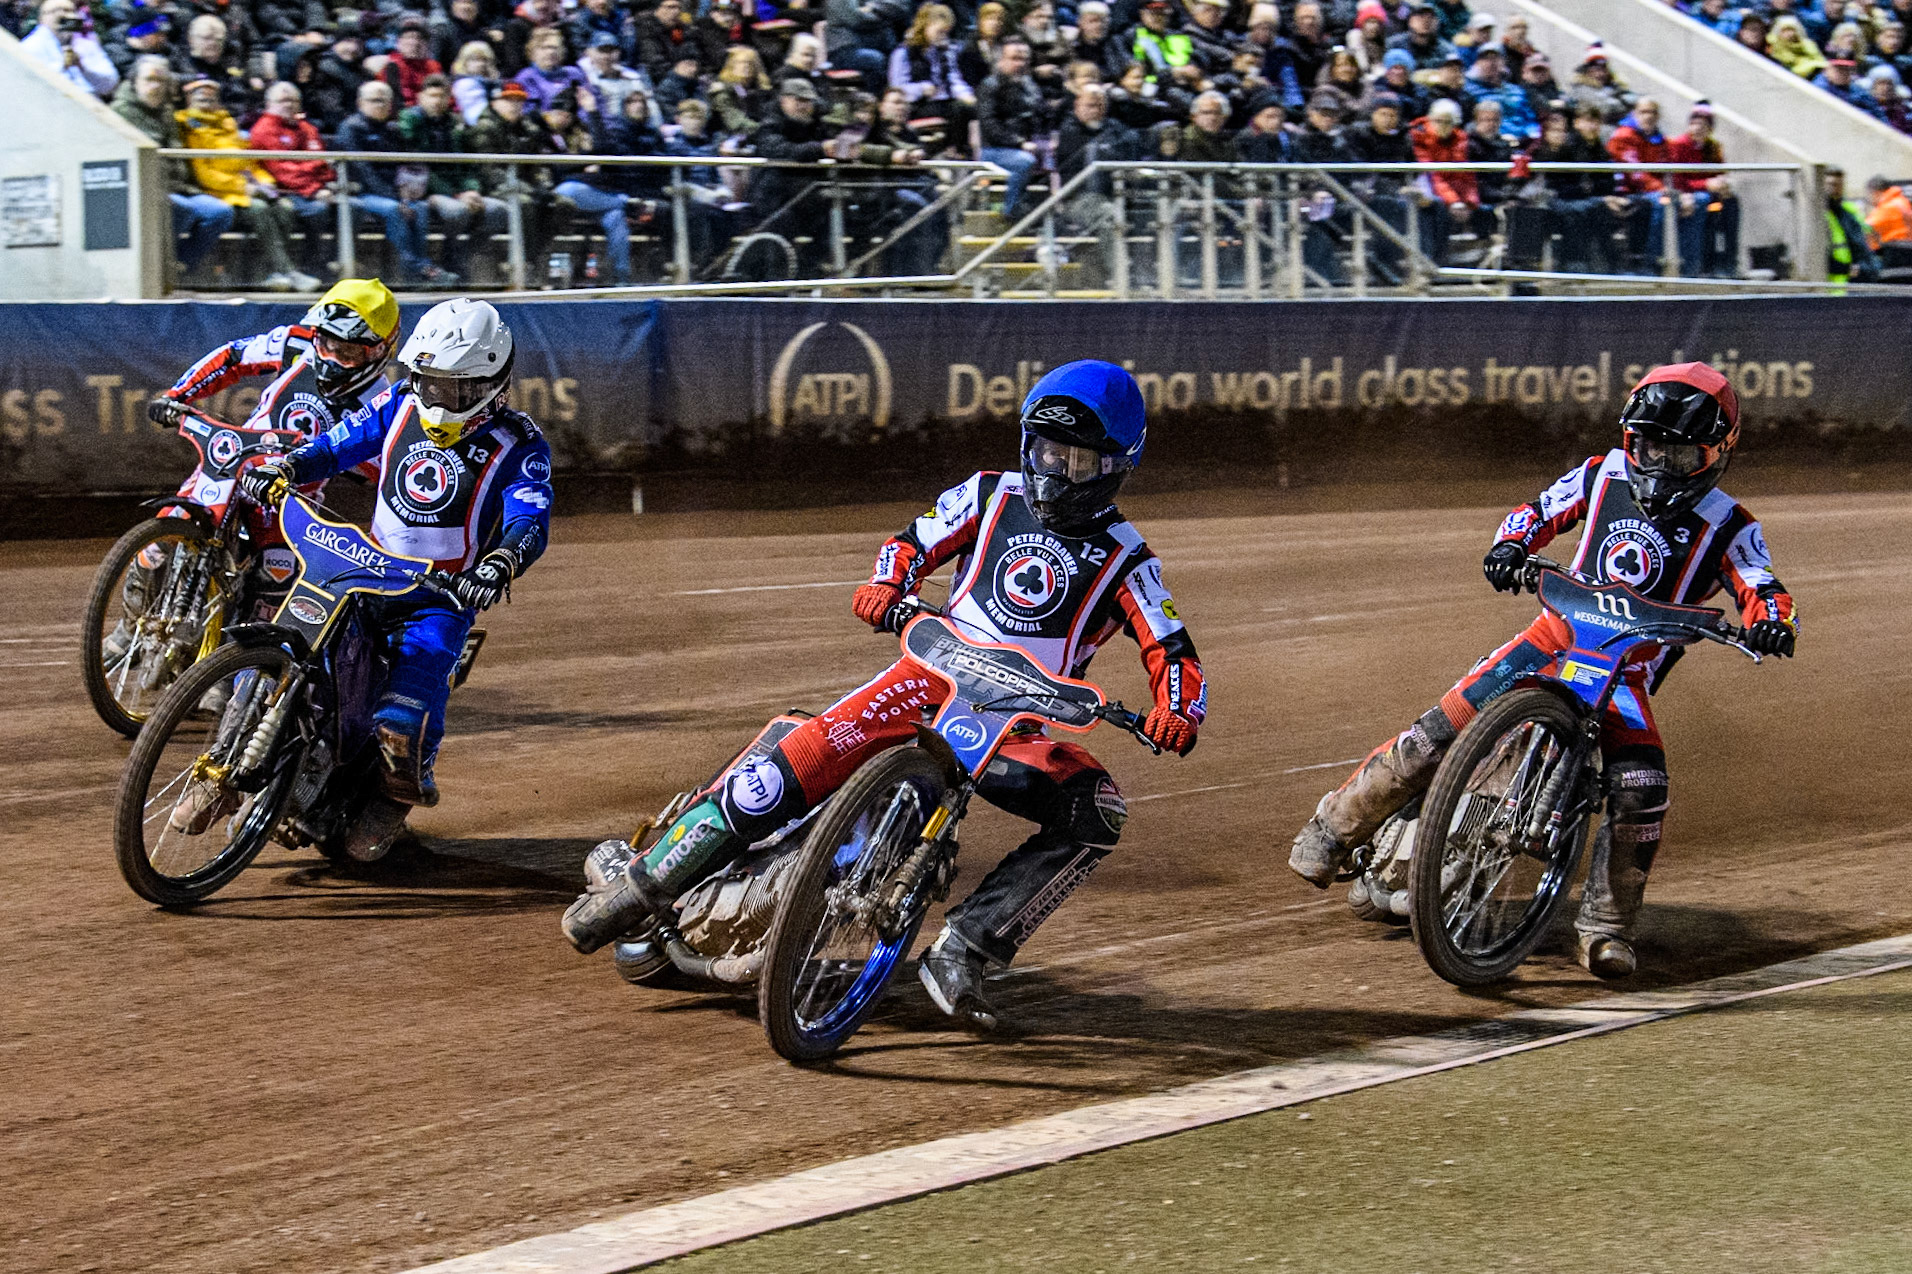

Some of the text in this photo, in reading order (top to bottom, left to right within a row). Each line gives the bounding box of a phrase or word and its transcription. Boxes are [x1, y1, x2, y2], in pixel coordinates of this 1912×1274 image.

[792, 372, 870, 416] ATPI
[1210, 356, 1344, 410] world
[1356, 354, 1470, 406] class
[1484, 351, 1612, 404] travel
[404, 451, 455, 485] BELLE VUE ACES
[466, 444, 489, 464] 13
[390, 495, 440, 523] MEMORIAL
[305, 522, 391, 575] GARCAREK
[1606, 532, 1660, 569] BELLE VUE ACES
[1608, 519, 1673, 557] PETER CRAVEN
[1673, 527, 1691, 544] 3
[1004, 547, 1065, 589] BELLE VUE ACES
[1007, 533, 1079, 576] PETER CRAVEN
[1079, 542, 1107, 567] 12
[984, 598, 1042, 632] MEMORIAL
[955, 653, 1054, 705] POLCOPPER
[861, 678, 929, 720] EASTERN
[879, 691, 928, 722] POINT
[948, 723, 980, 742] ATPI
